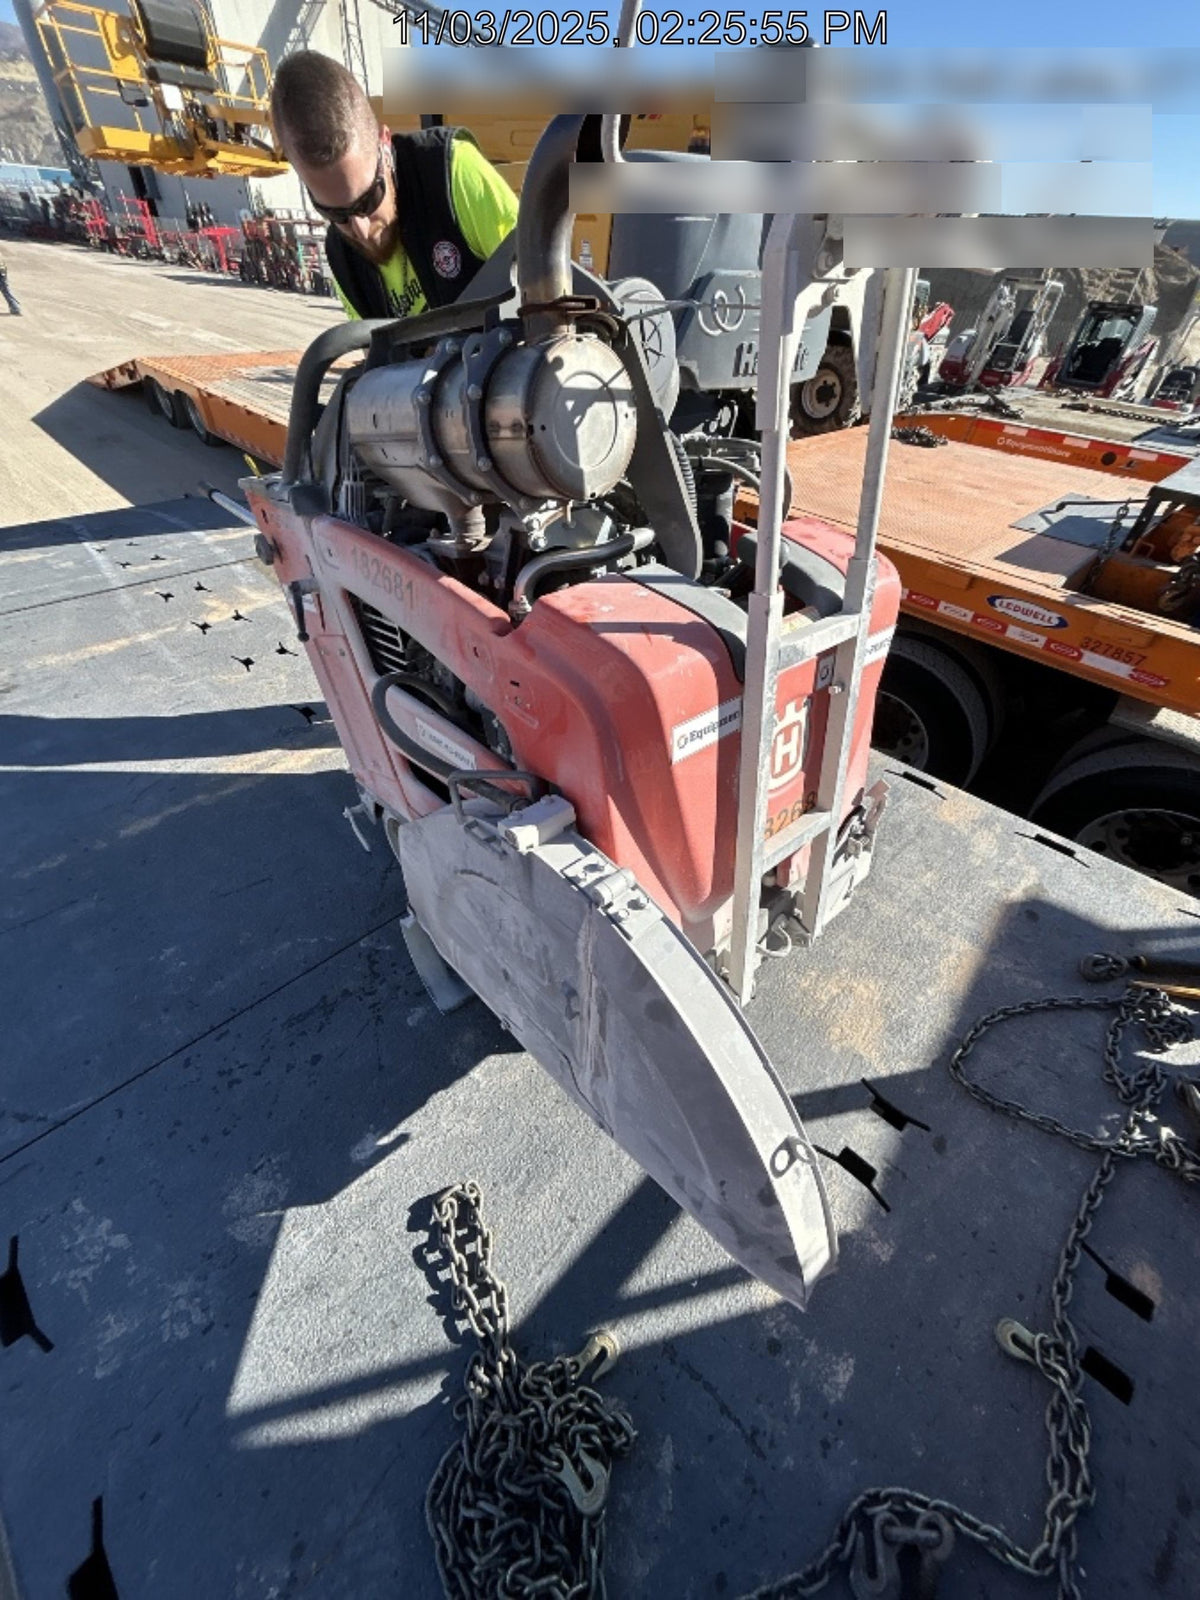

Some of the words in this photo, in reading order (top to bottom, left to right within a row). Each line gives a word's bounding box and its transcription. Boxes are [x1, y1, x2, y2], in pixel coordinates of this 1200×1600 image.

[351, 544, 414, 609] 182681
[1000, 600, 1055, 624] LEDWELL
[1080, 636, 1147, 666] 327857
